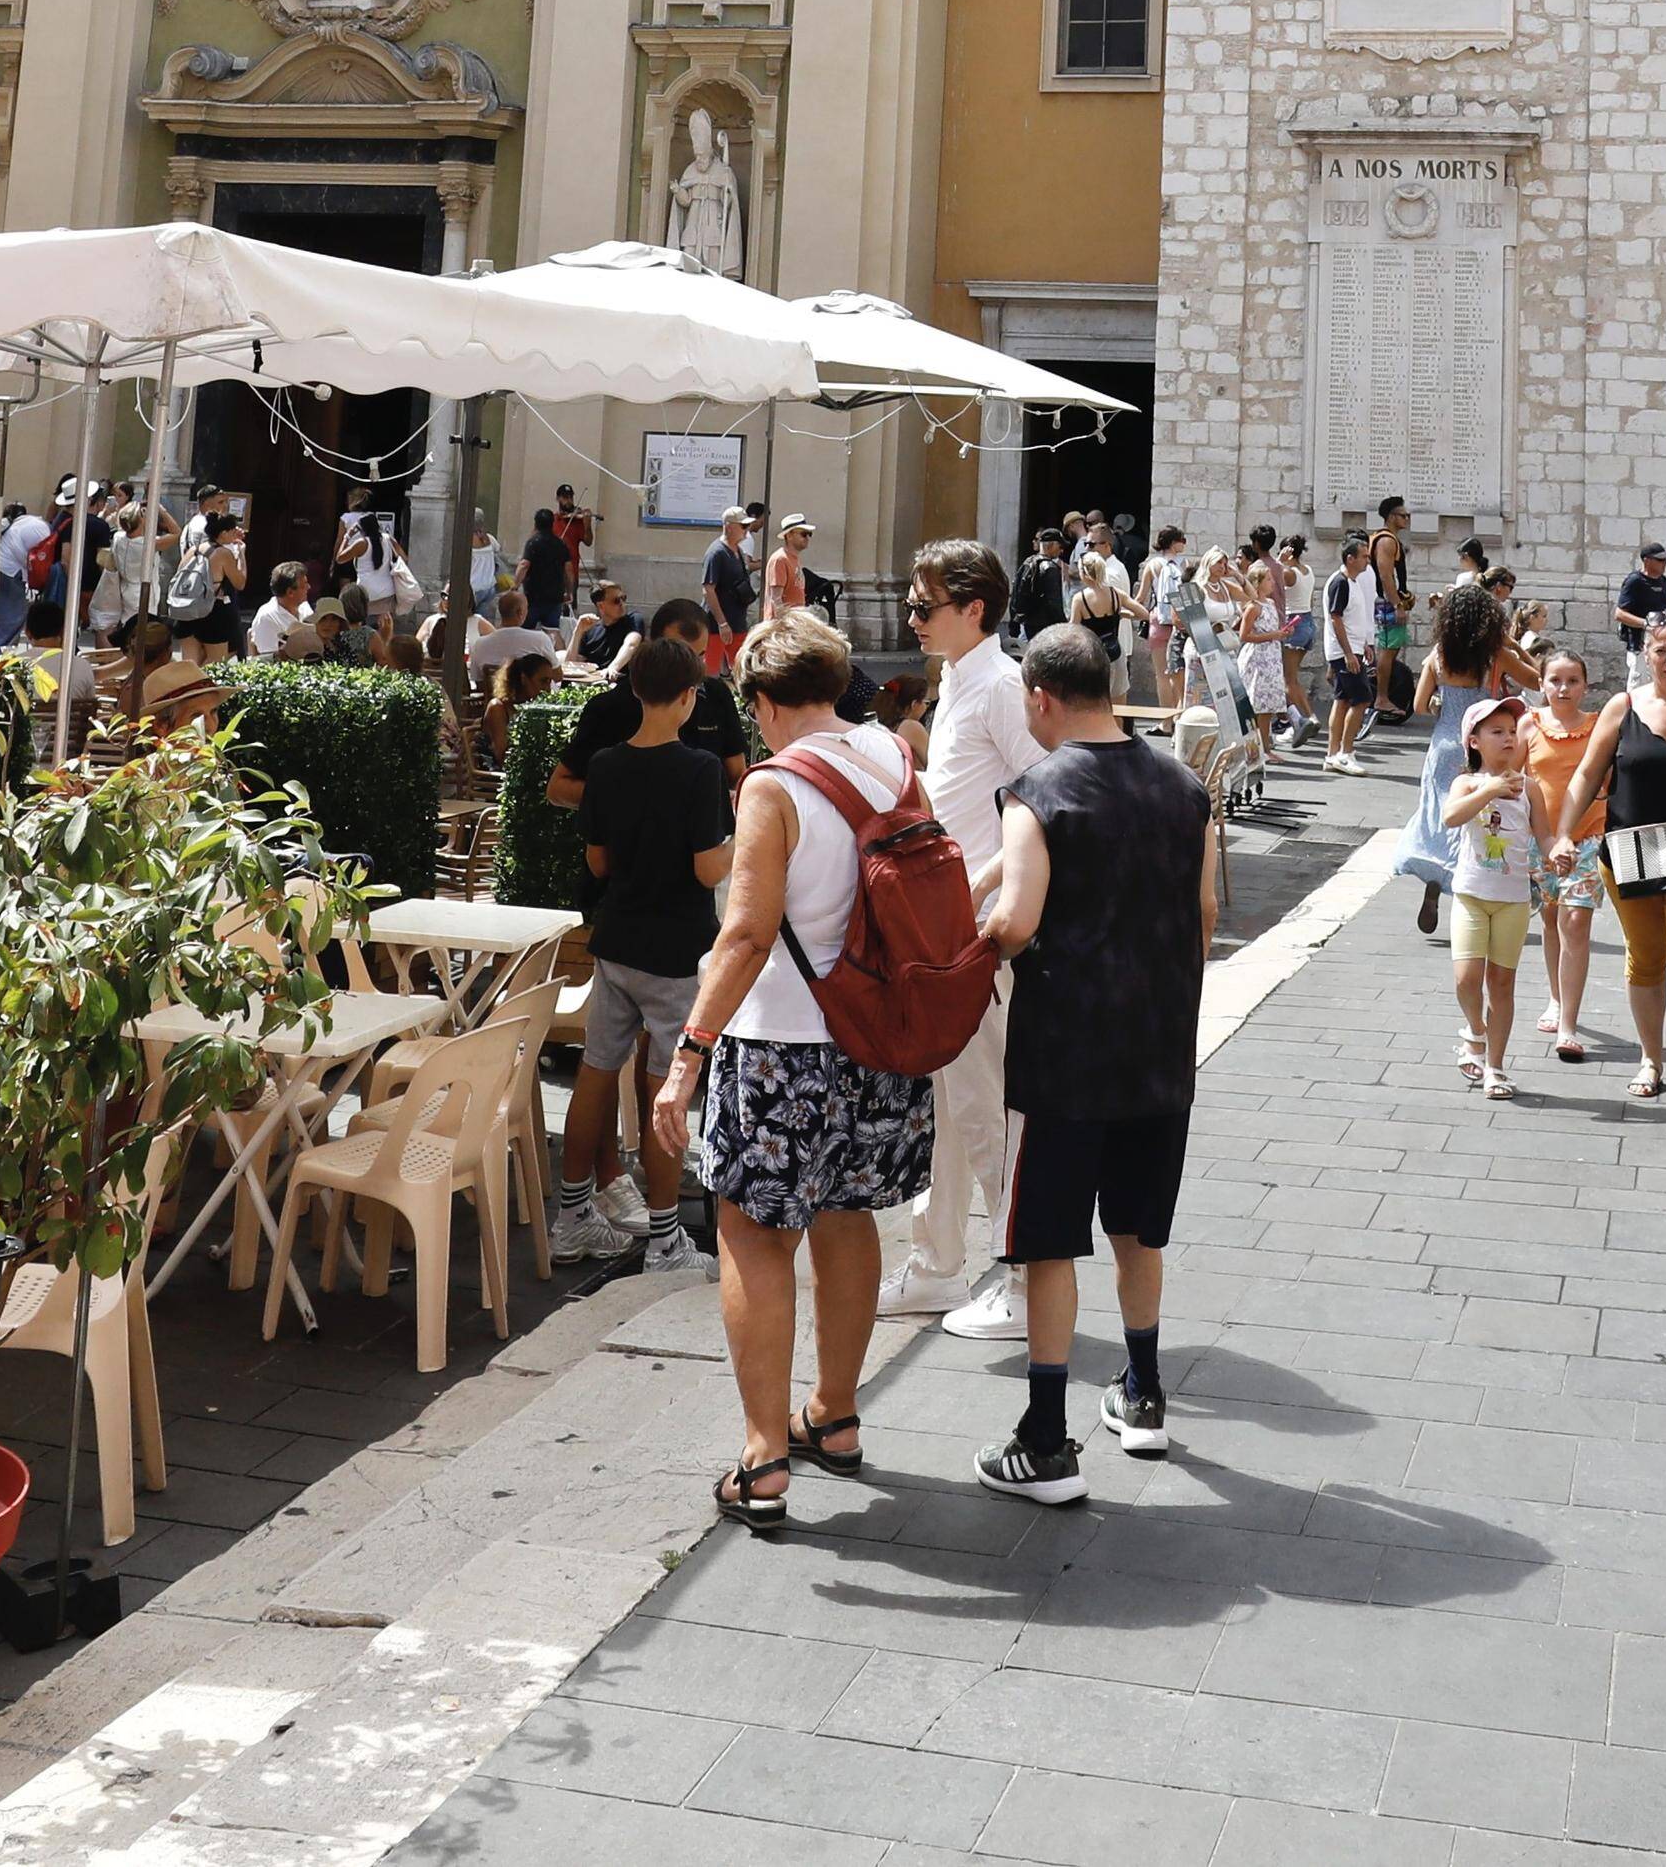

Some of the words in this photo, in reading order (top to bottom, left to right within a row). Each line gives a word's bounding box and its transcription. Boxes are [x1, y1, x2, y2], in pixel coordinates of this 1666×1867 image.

[1329, 158, 1344, 178] A
[1355, 158, 1403, 179] NOS
[1414, 159, 1498, 180] MORTS
[1325, 201, 1369, 226] 1914
